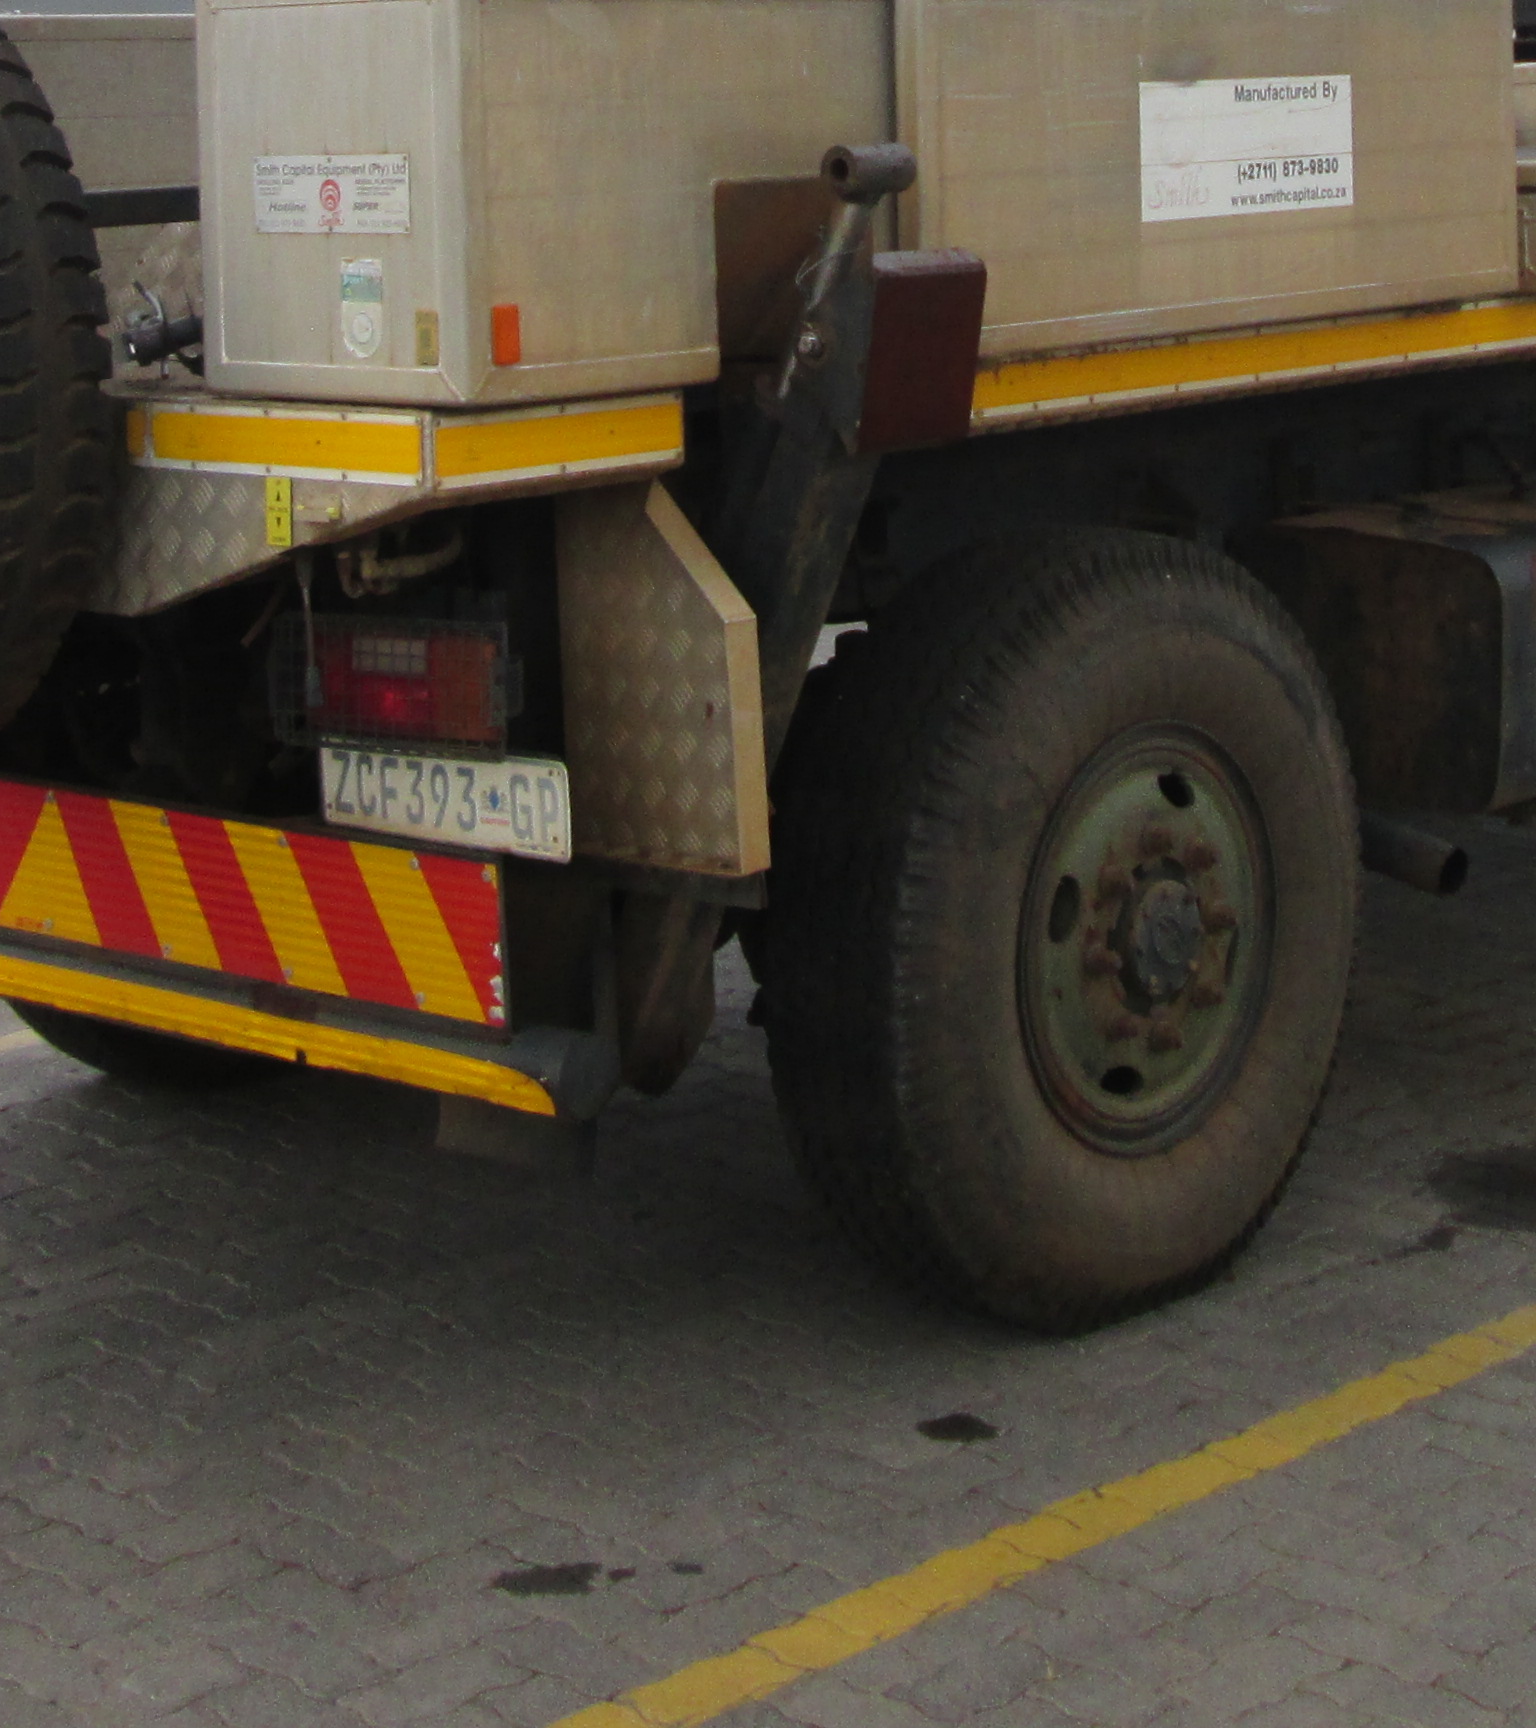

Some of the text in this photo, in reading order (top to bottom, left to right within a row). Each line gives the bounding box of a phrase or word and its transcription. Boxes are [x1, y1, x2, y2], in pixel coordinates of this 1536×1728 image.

[1234, 81, 1338, 103] Manufactured By
[256, 162, 406, 177] Smith Capital Equipment (Pty) Ltd
[1237, 157, 1339, 184] (+2711) 873-9830
[269, 201, 307, 212] Hotline
[352, 201, 379, 212] SUPER
[1230, 186, 1347, 208] www.smithcapital.co.za
[331, 750, 561, 842] ZCF393 GP
